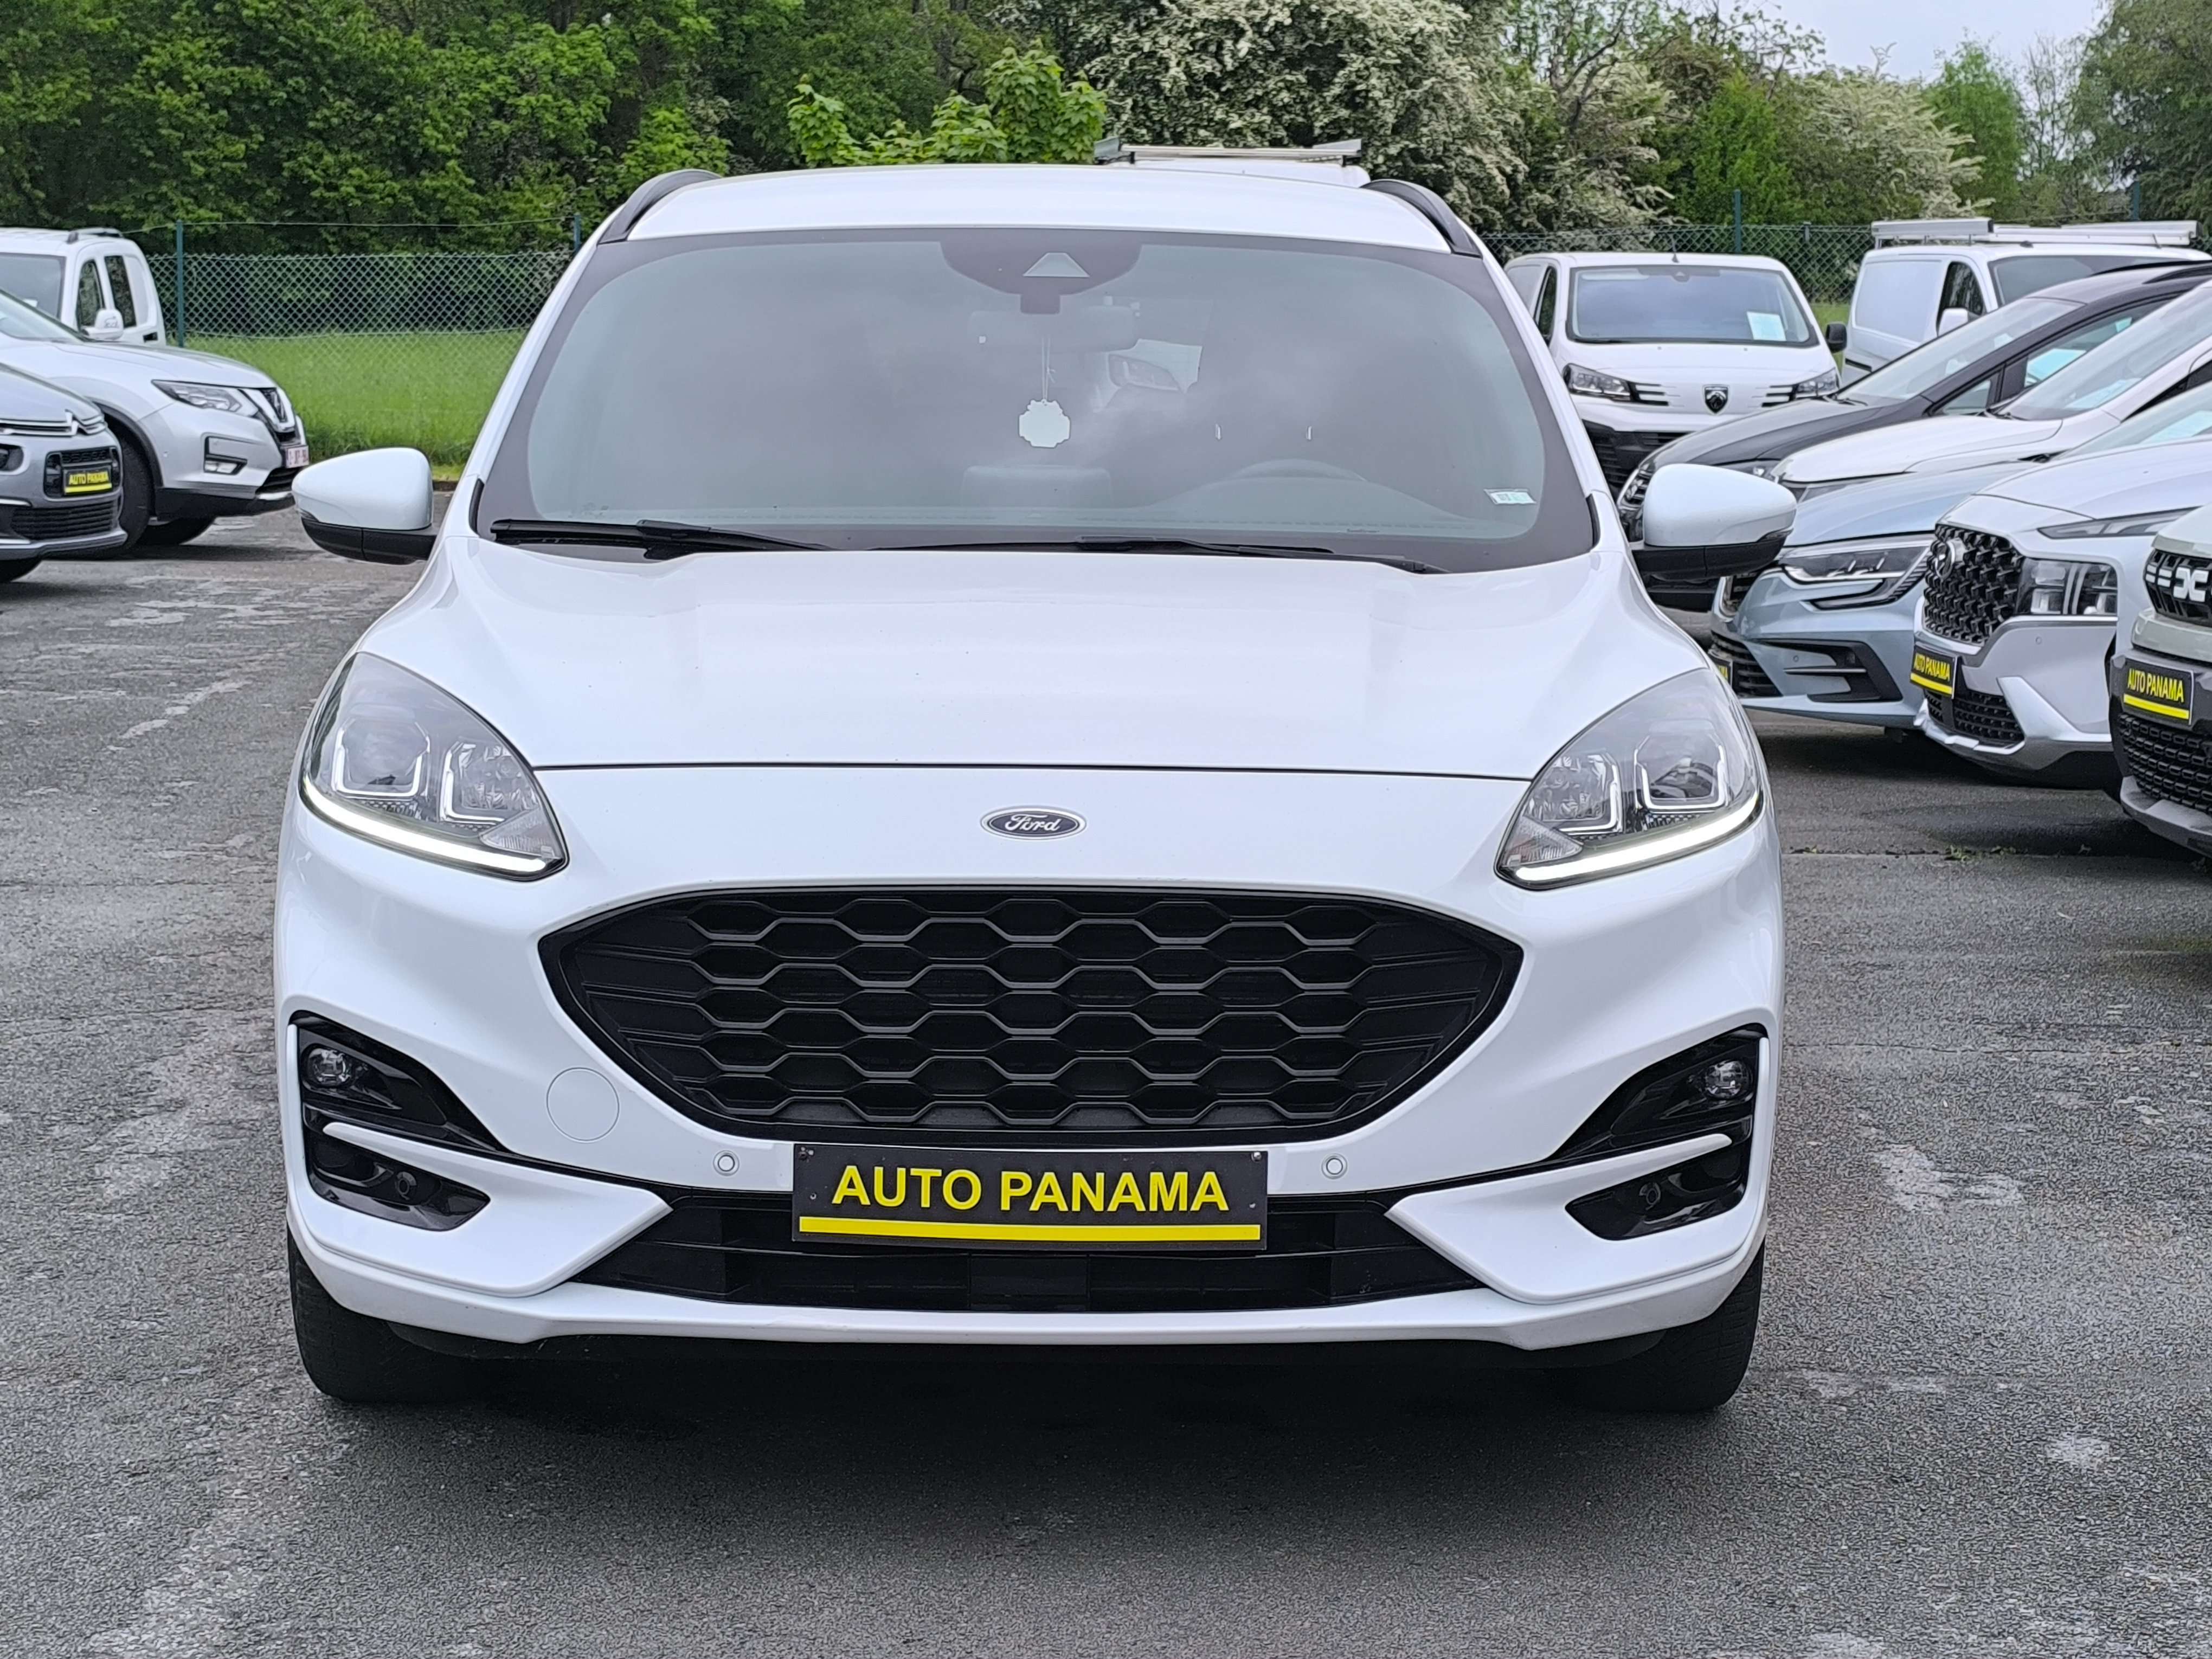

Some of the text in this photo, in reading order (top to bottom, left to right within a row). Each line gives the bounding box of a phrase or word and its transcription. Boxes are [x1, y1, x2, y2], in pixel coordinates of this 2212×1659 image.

[2128, 668, 2184, 703] AUTO PANAMA
[1005, 814, 1062, 831] Ford
[833, 1166, 1228, 1212] AUTO PANAMA
